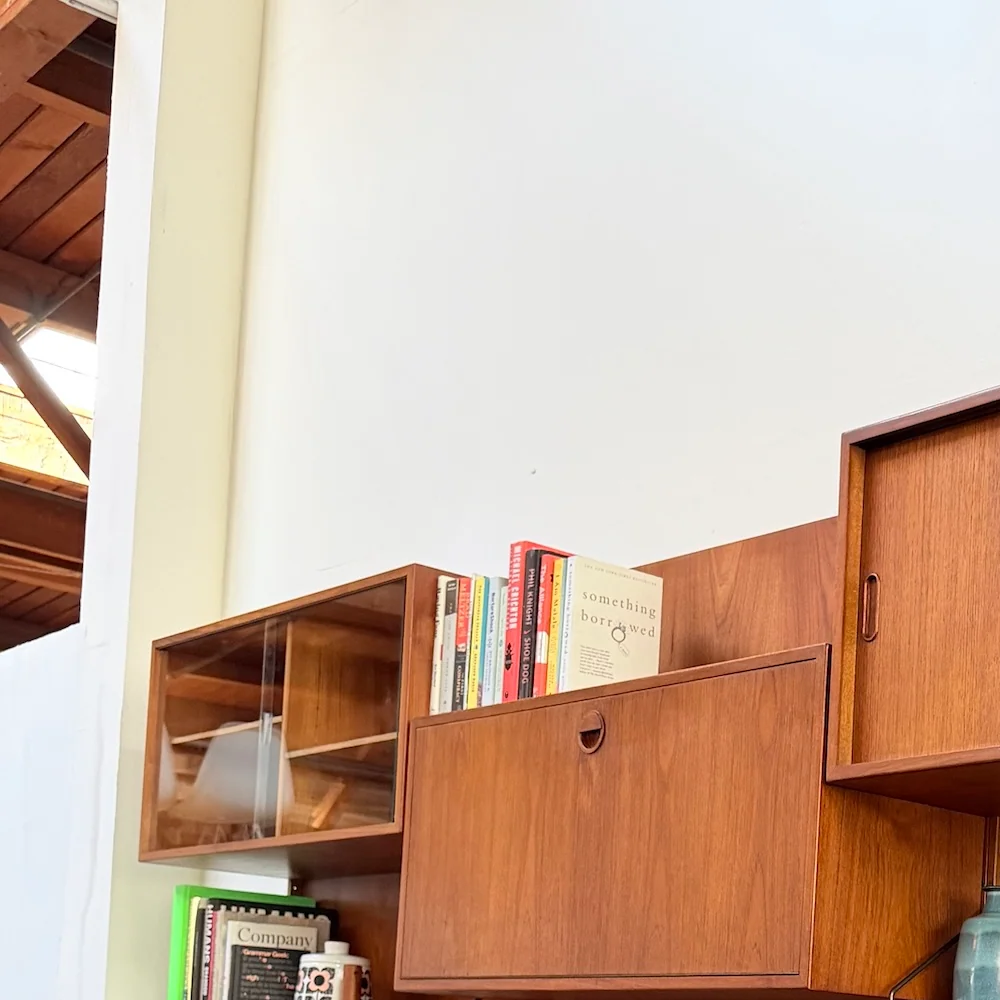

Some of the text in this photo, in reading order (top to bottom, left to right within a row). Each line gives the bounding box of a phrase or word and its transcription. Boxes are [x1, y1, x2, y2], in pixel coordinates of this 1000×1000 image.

[512, 545, 522, 584] MICHAEL
[539, 564, 547, 584] The
[457, 584, 467, 629] MELTZER
[509, 586, 520, 629] CRICHTON
[525, 568, 536, 627] PHIL KNIGHT
[582, 591, 656, 619] something
[521, 637, 531, 685] SHOE DOG
[204, 904, 214, 963] HUMANS
[237, 927, 313, 950] Company
